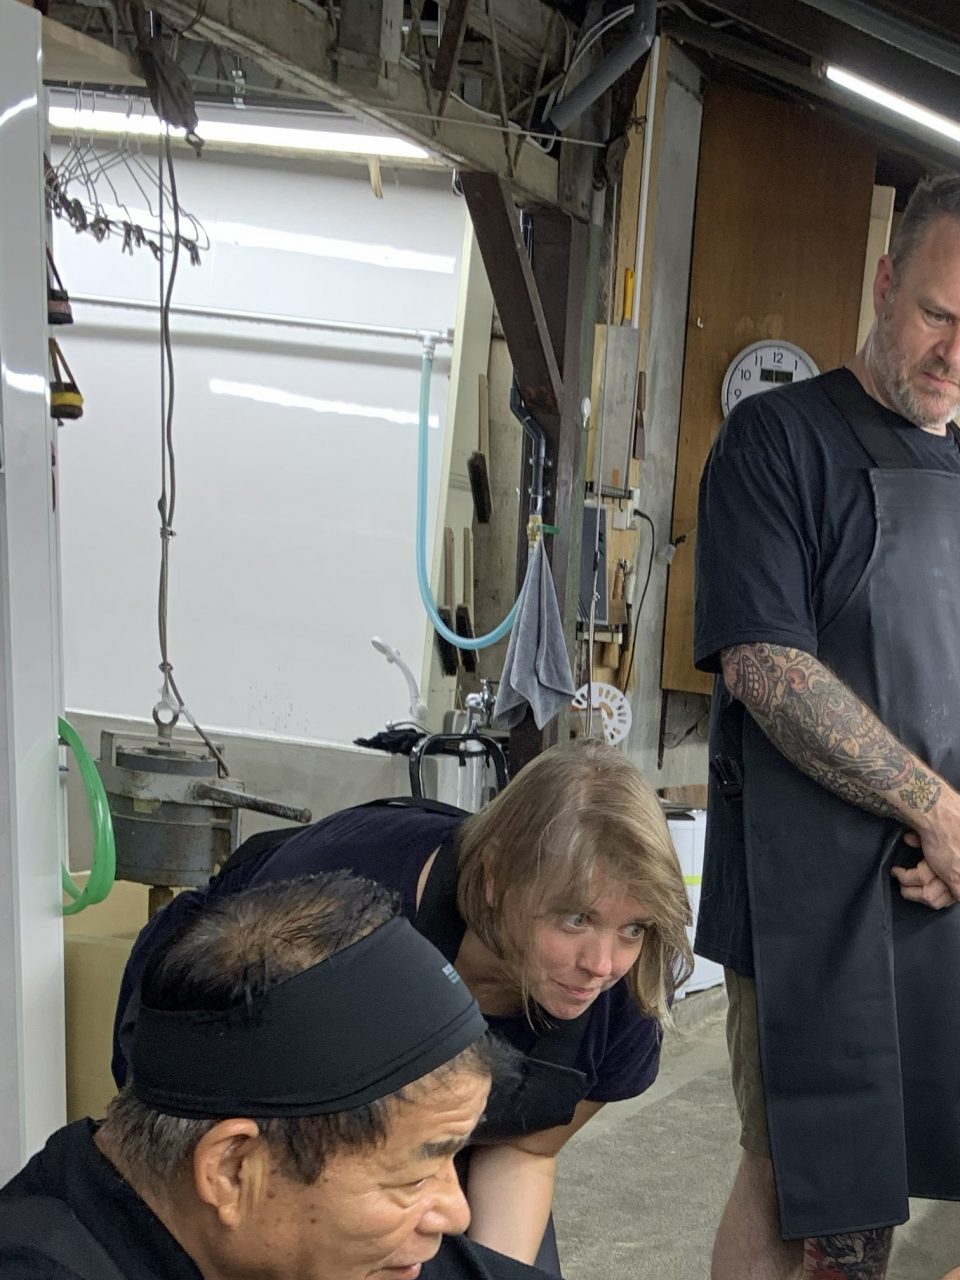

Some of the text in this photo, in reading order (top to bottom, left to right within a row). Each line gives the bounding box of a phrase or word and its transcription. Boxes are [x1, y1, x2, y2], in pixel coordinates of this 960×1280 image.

[754, 354, 763, 367] 11
[773, 351, 784, 364] 12
[740, 369, 752, 381] 10
[734, 388, 742, 400] 9
